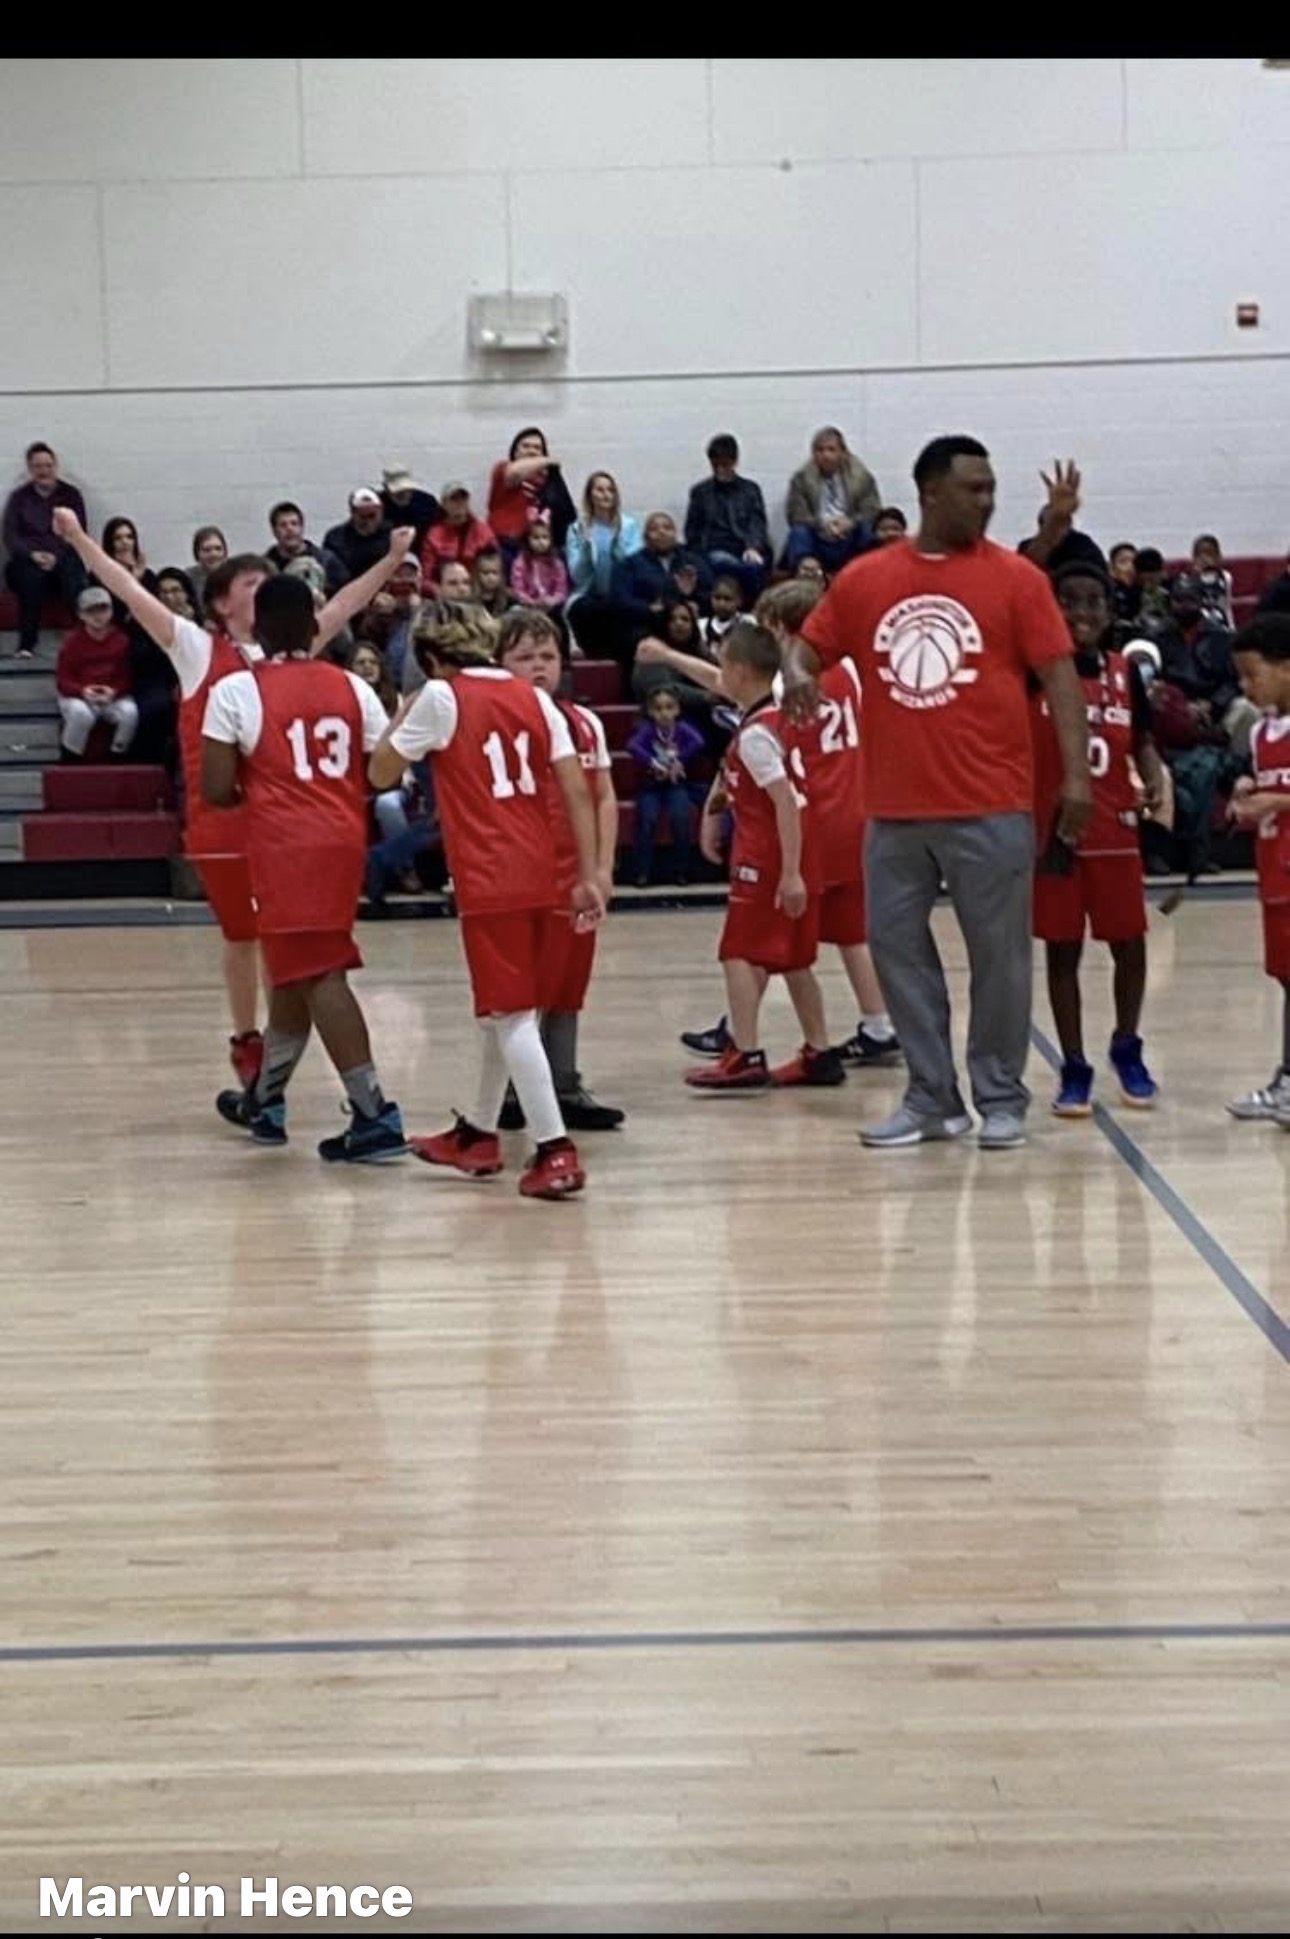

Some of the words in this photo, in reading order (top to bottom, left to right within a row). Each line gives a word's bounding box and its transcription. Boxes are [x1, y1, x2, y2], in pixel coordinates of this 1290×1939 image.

[286, 716, 350, 781] 13
[818, 697, 859, 753] 21
[483, 730, 537, 799] 11
